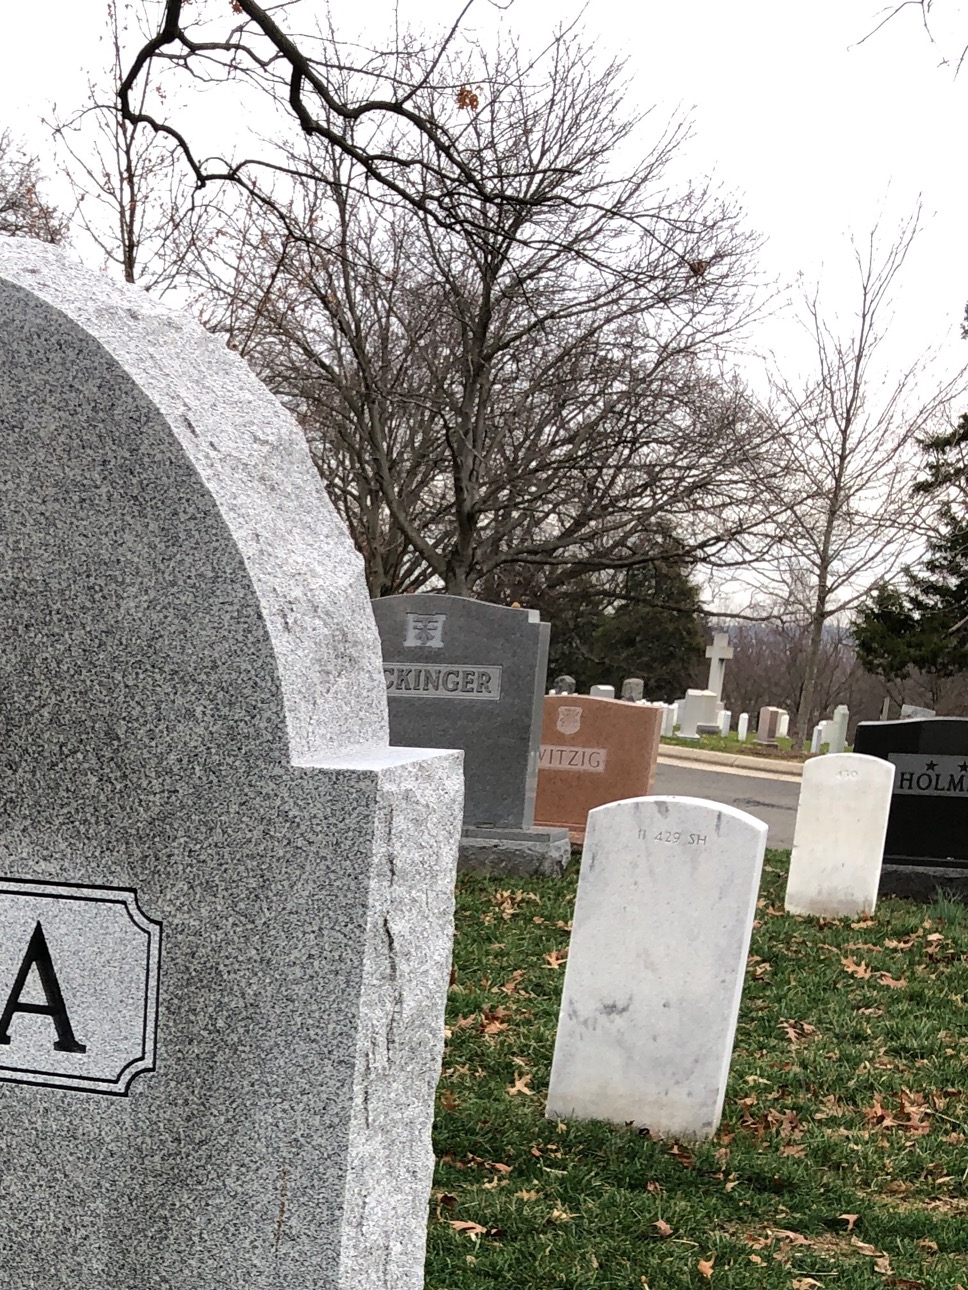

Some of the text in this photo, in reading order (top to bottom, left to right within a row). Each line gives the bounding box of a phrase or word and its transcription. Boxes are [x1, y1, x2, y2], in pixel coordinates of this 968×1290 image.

[899, 771, 968, 792] HOLM
[654, 831, 682, 844] 429
[688, 833, 708, 846] SH
